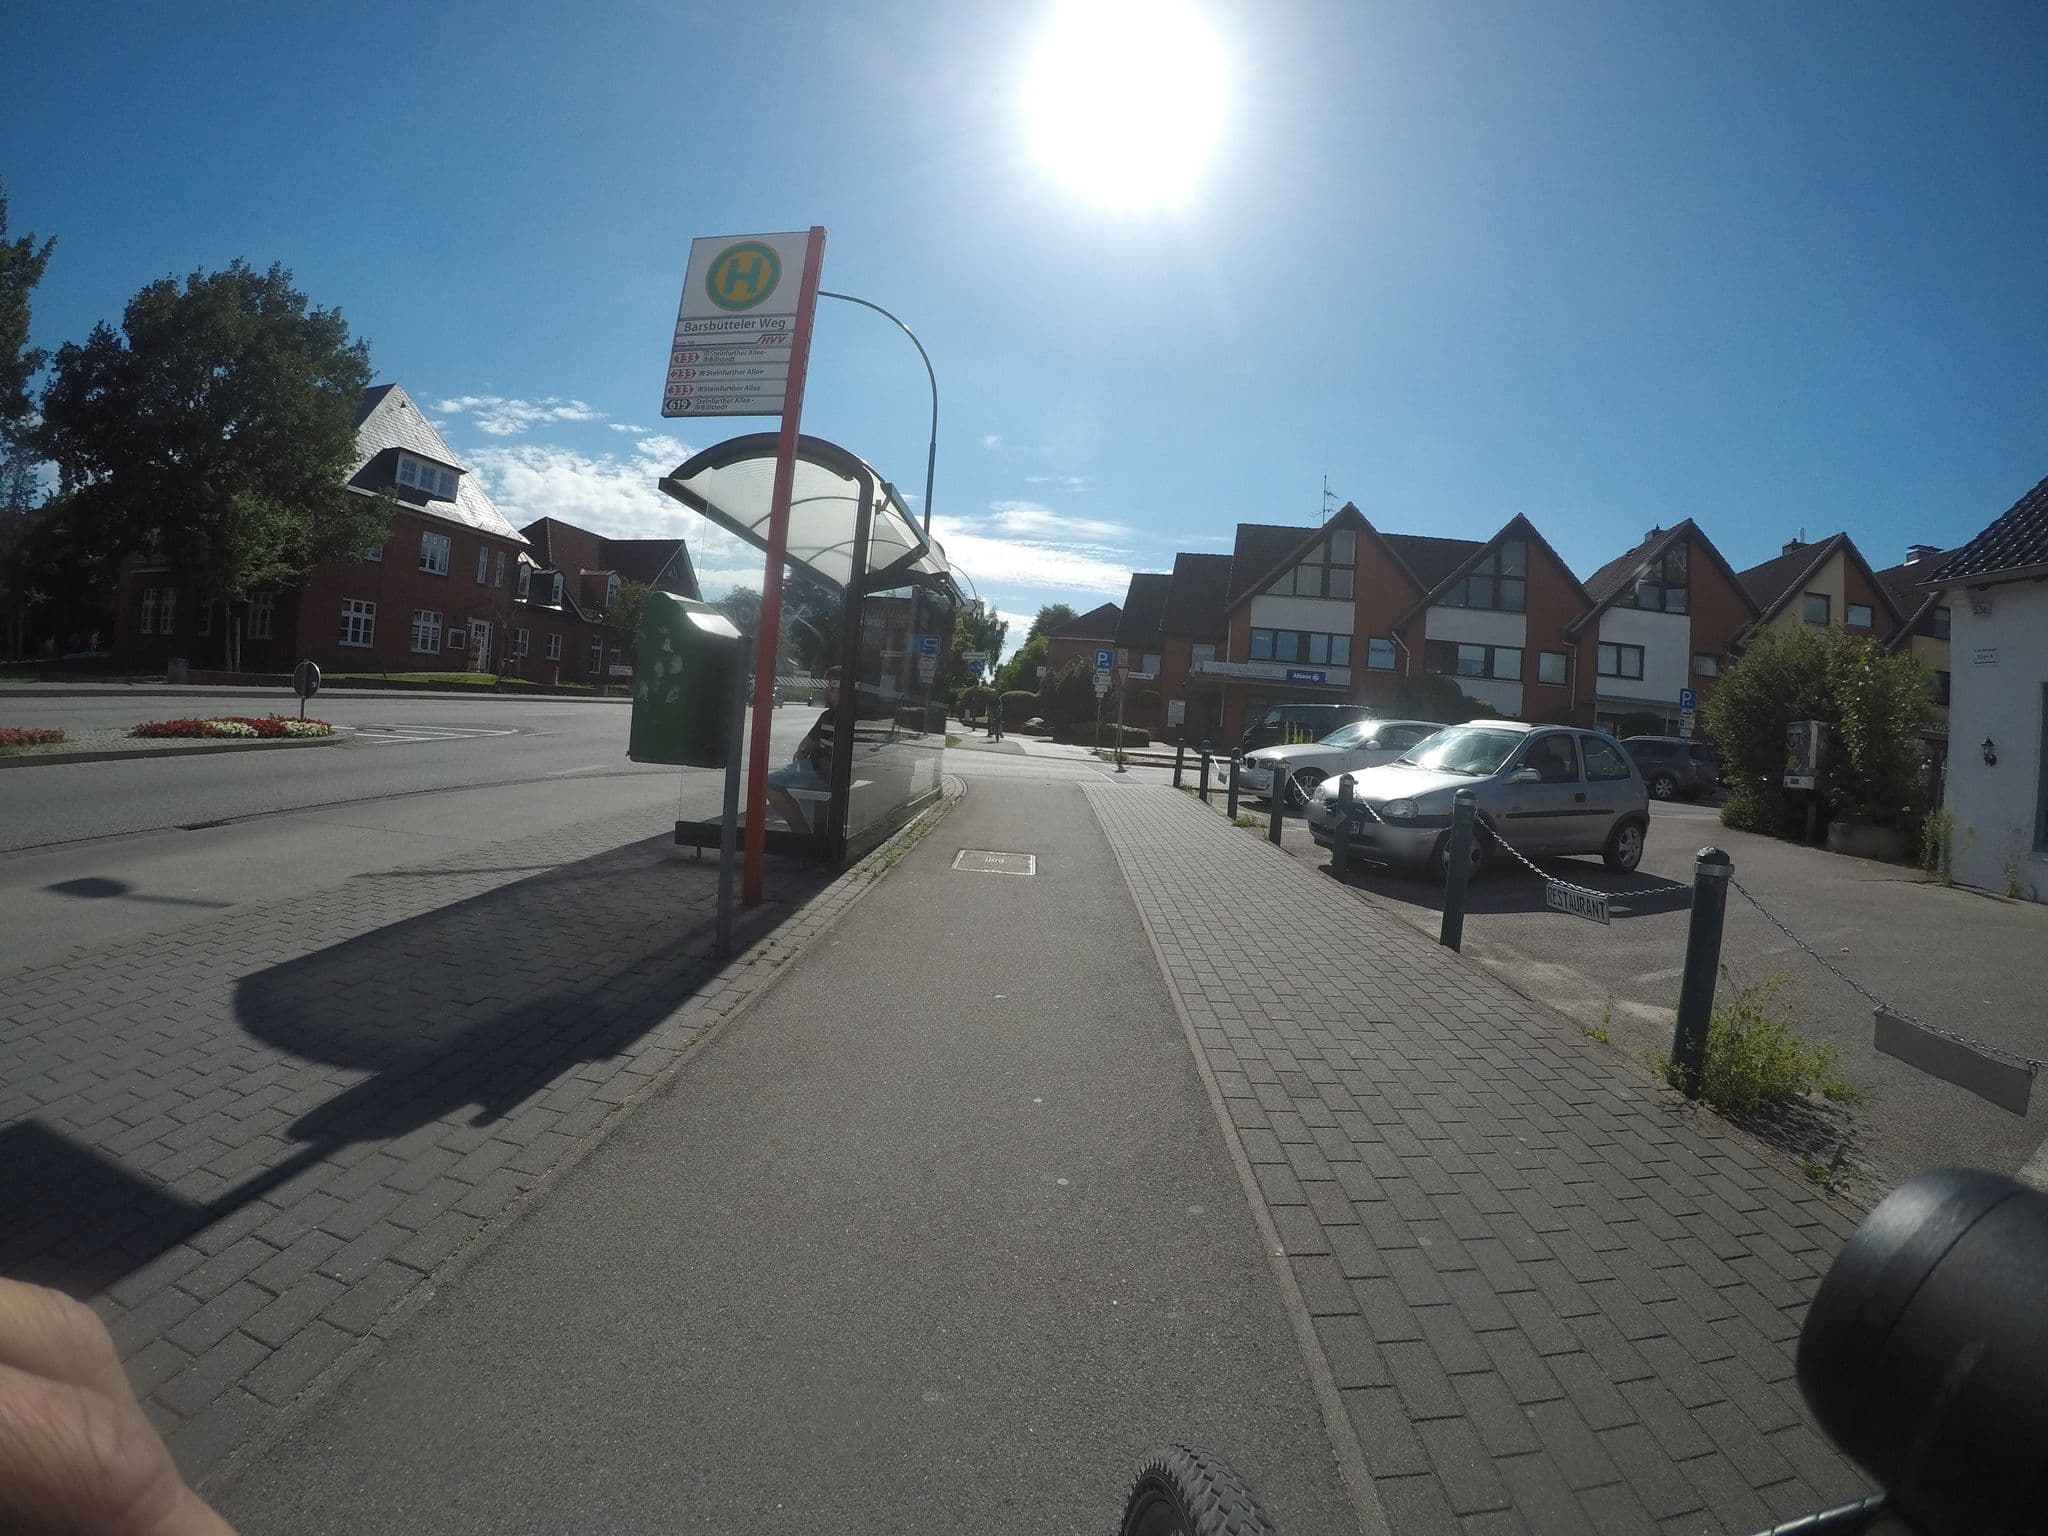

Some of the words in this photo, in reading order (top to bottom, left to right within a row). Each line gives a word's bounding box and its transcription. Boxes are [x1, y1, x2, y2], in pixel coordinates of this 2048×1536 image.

[724, 258, 763, 295] H
[684, 319, 757, 333] Barsbütteler
[760, 318, 786, 331] Weg
[676, 352, 698, 363] 133
[711, 349, 748, 357] Steinfurther
[673, 369, 694, 379] 233
[705, 369, 746, 377] Steinfurther
[670, 385, 692, 395] 333
[668, 400, 689, 410] 619
[1097, 652, 1108, 666] P
[1682, 691, 1692, 706] P
[1547, 886, 1605, 920] RESTAURANT
